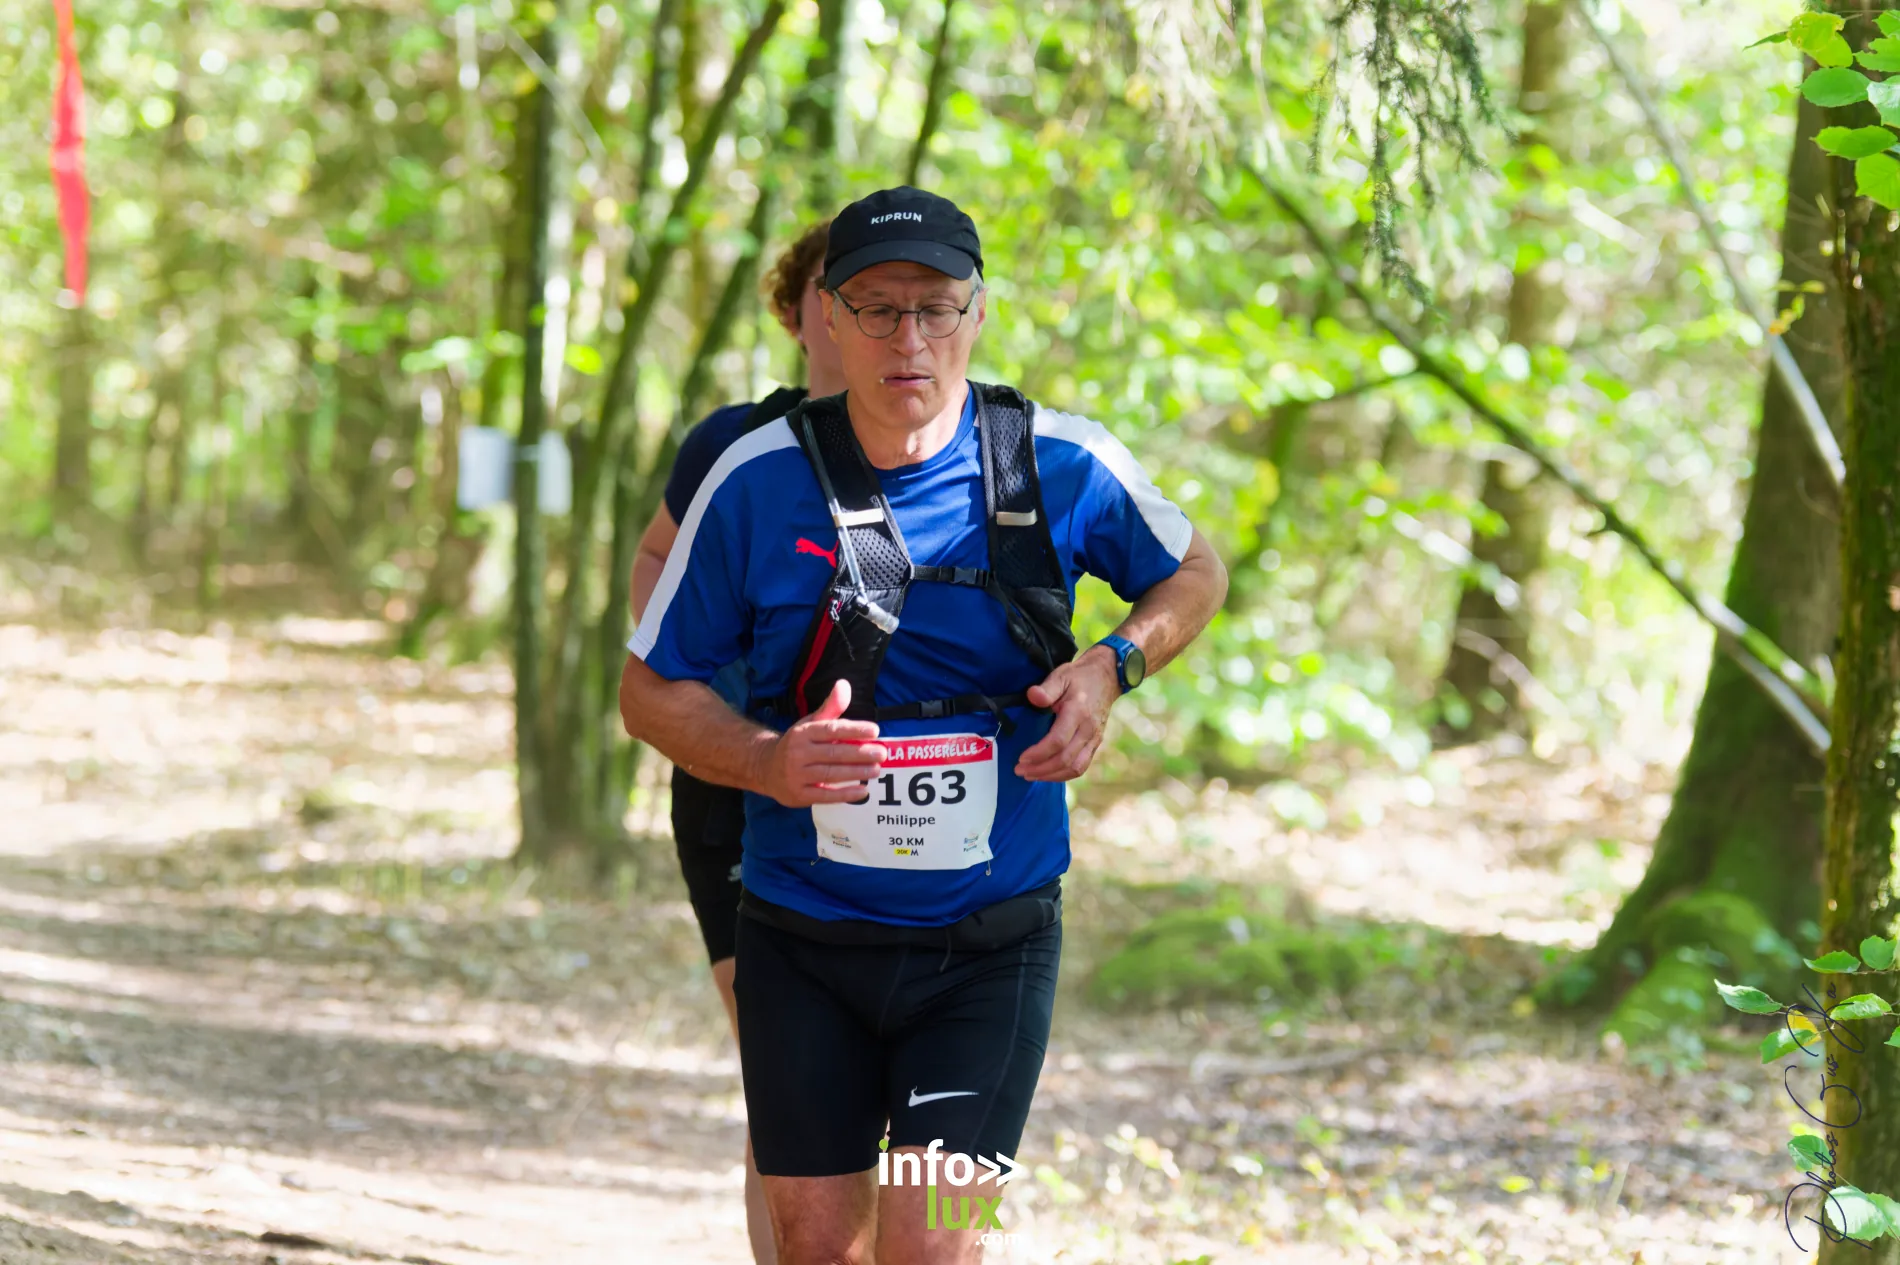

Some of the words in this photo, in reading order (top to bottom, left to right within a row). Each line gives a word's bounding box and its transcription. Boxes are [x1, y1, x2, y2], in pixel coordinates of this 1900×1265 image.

[870, 212, 922, 225] KIPRUN
[887, 746, 905, 761] LA
[907, 741, 979, 761] PASSERELLE
[876, 814, 936, 828] Philippe
[888, 836, 904, 846] 30
[906, 837, 925, 847] KM
[910, 848, 919, 857] M
